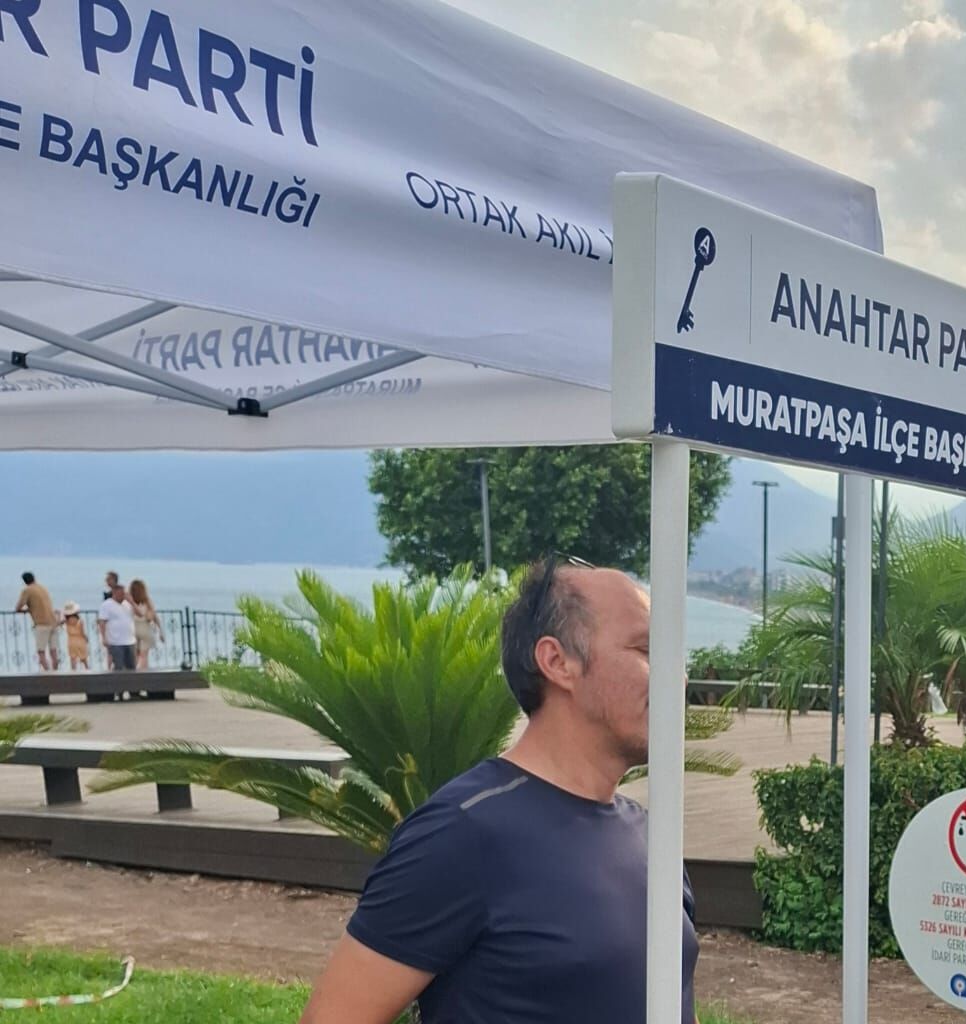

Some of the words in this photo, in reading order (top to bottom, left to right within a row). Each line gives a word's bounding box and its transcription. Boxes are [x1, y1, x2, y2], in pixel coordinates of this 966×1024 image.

[78, 0, 319, 148] PARTİ
[39, 112, 322, 229] BAŞKANLIĞI
[404, 170, 527, 240] ORTAK
[535, 212, 602, 261] AKIL
[770, 271, 931, 365] ANAHTAR
[710, 381, 869, 455] MURATPAŞA
[873, 406, 920, 465] İLÇE
